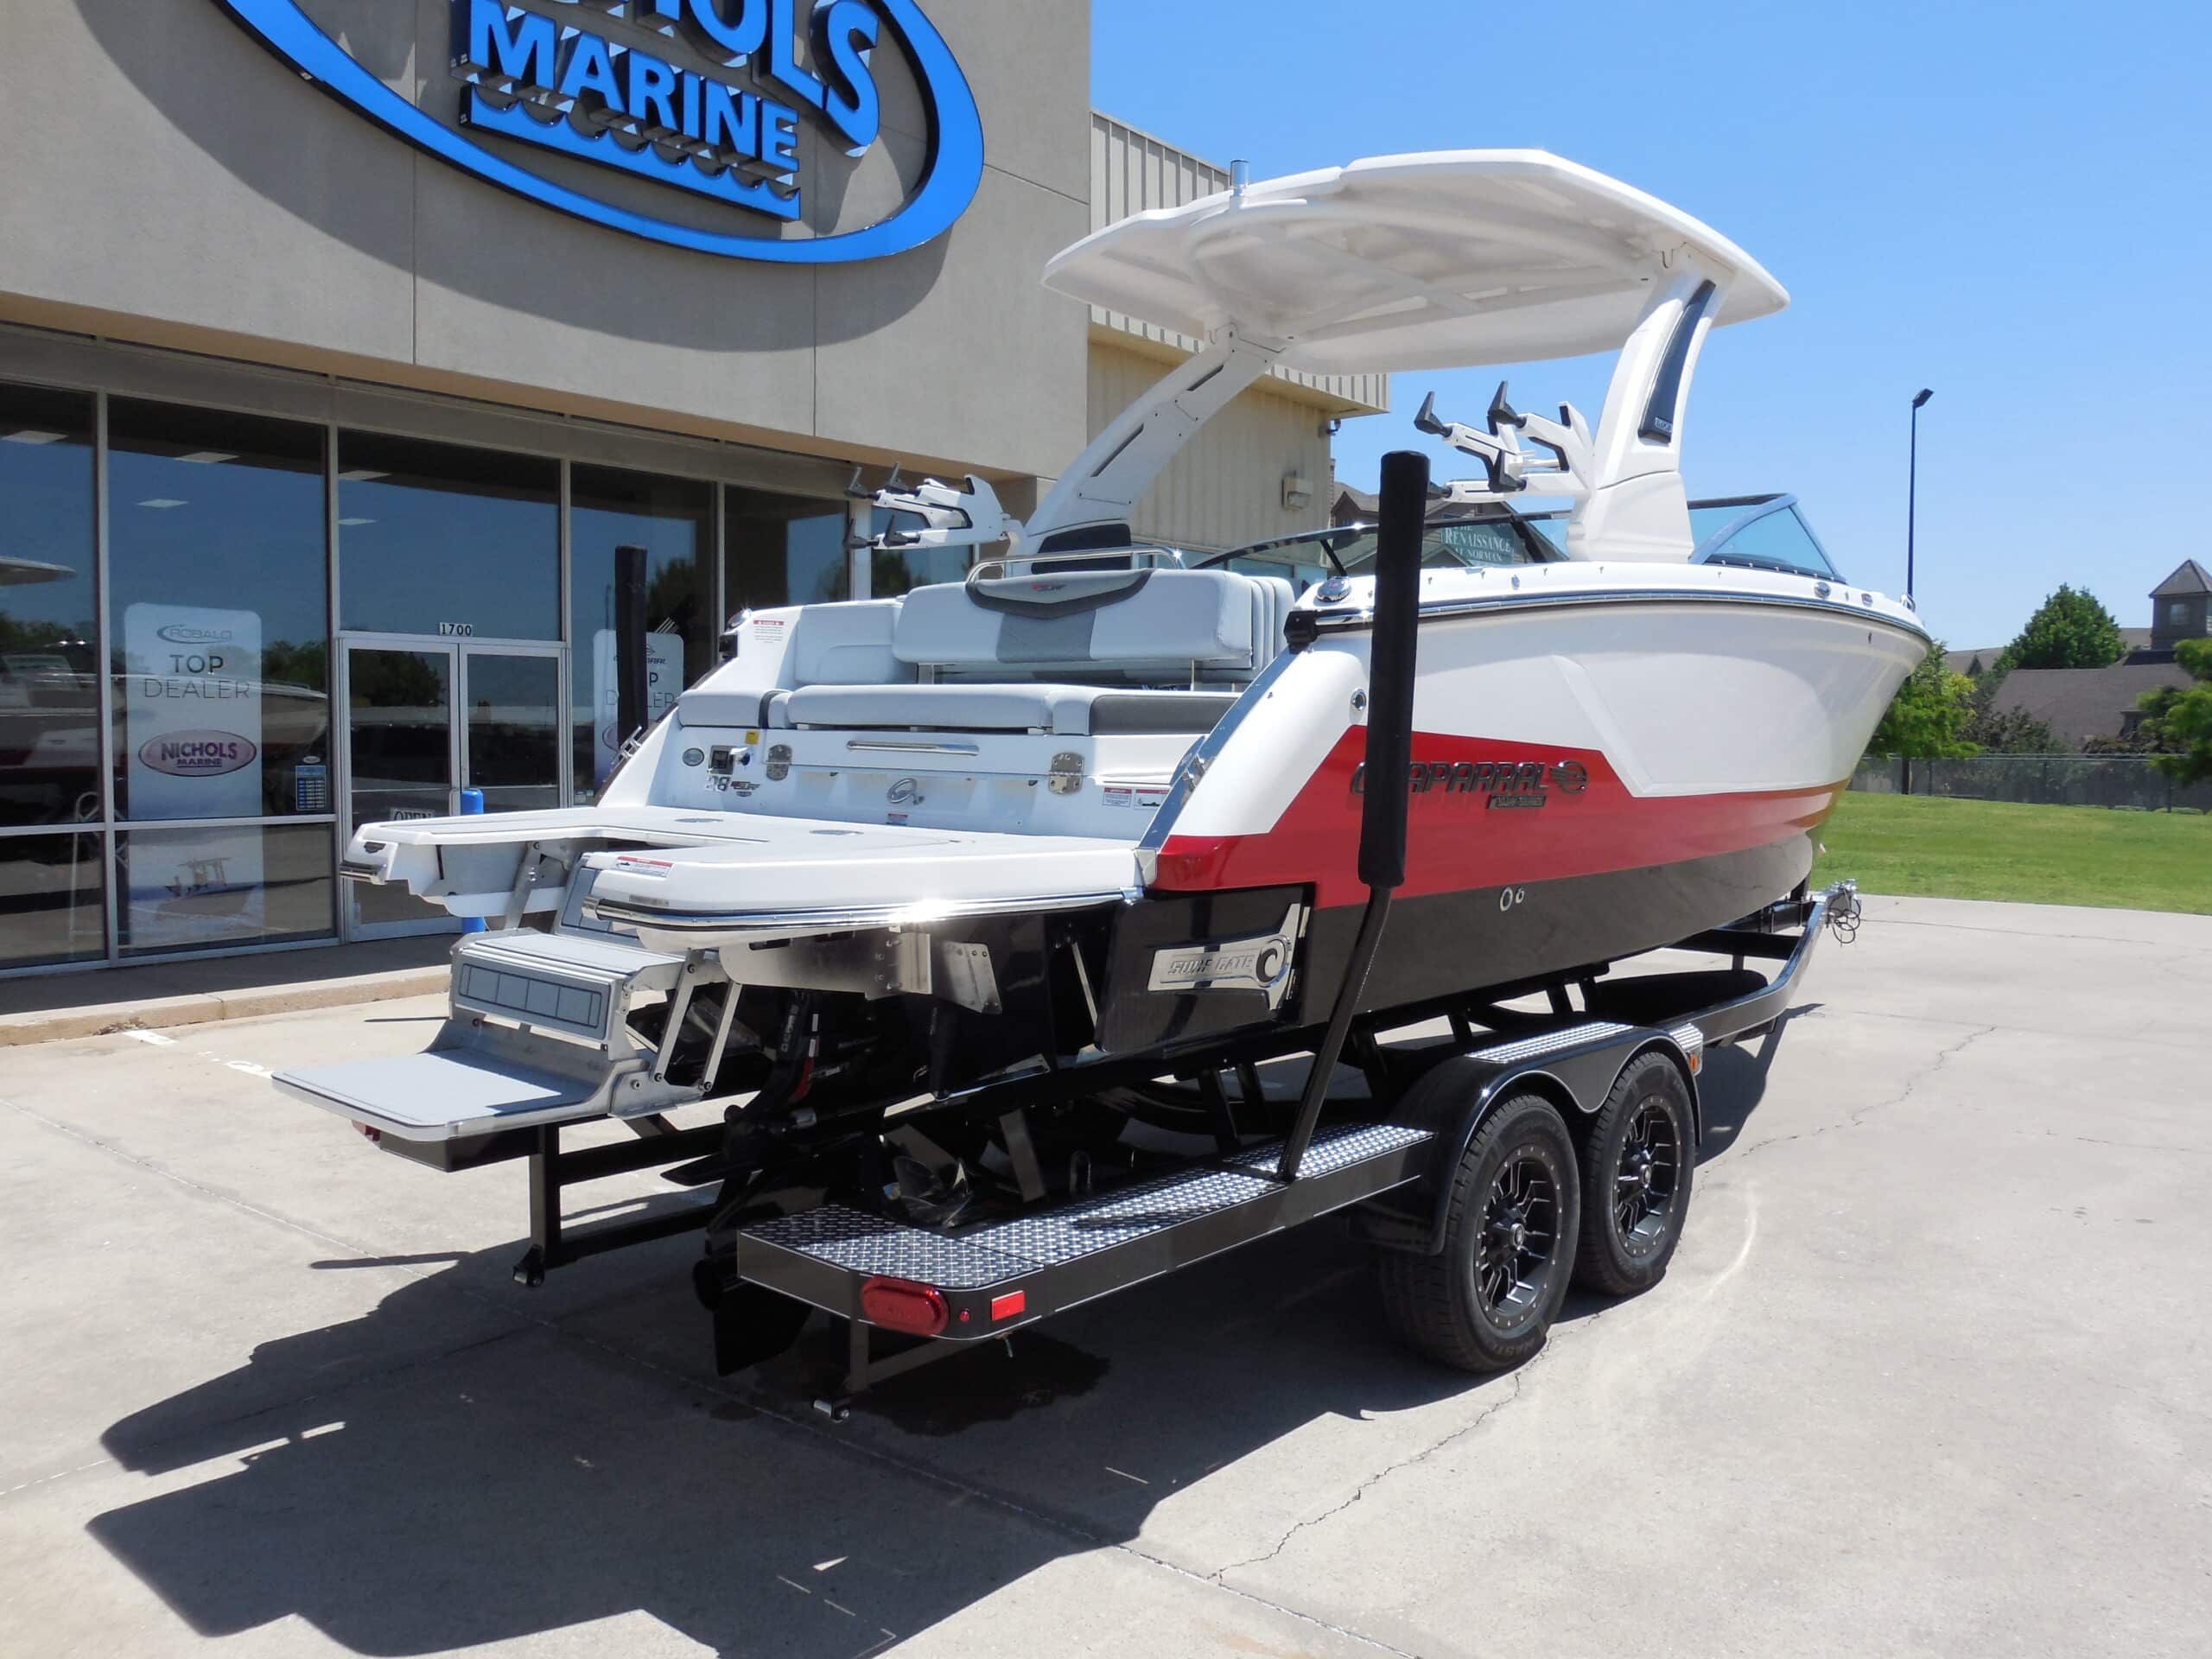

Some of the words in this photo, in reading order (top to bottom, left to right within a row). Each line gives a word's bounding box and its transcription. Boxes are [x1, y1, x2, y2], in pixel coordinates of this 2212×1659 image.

[471, 0, 799, 172] MARINE
[1445, 526, 1511, 553] RENAISSANCE
[1467, 548, 1503, 562] NORMAN
[442, 623, 472, 637] 1700
[169, 654, 225, 674] TOP
[144, 677, 250, 699] DEALER
[161, 741, 238, 761] NICHOLS
[175, 758, 222, 766] MARINE
[1351, 761, 1549, 794] CAPARRAL
